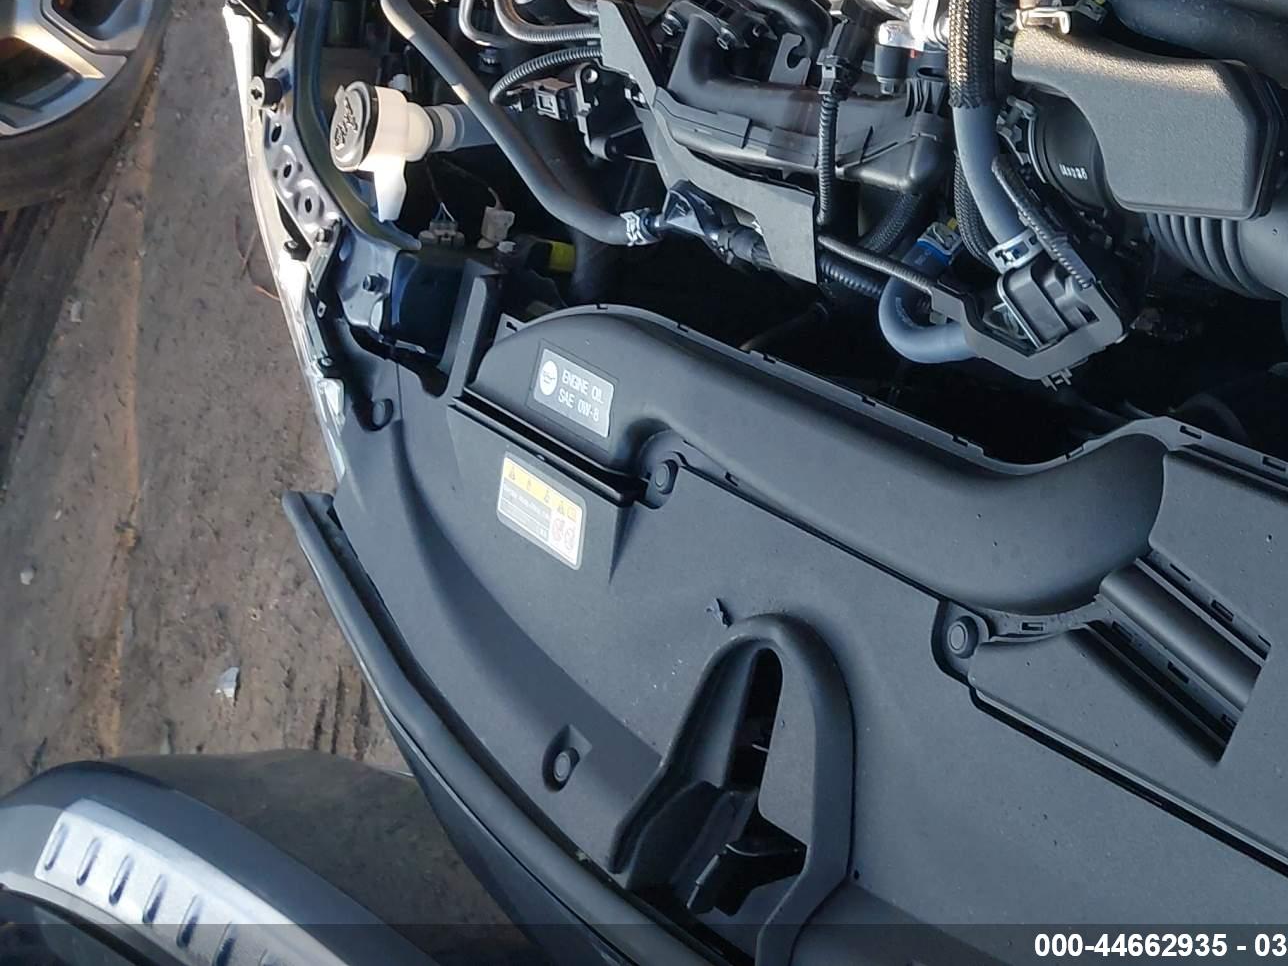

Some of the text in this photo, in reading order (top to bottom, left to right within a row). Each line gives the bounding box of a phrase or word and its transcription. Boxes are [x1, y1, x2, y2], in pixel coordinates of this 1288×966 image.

[558, 388, 575, 408] SAE
[562, 369, 604, 404] ENGINE OIL
